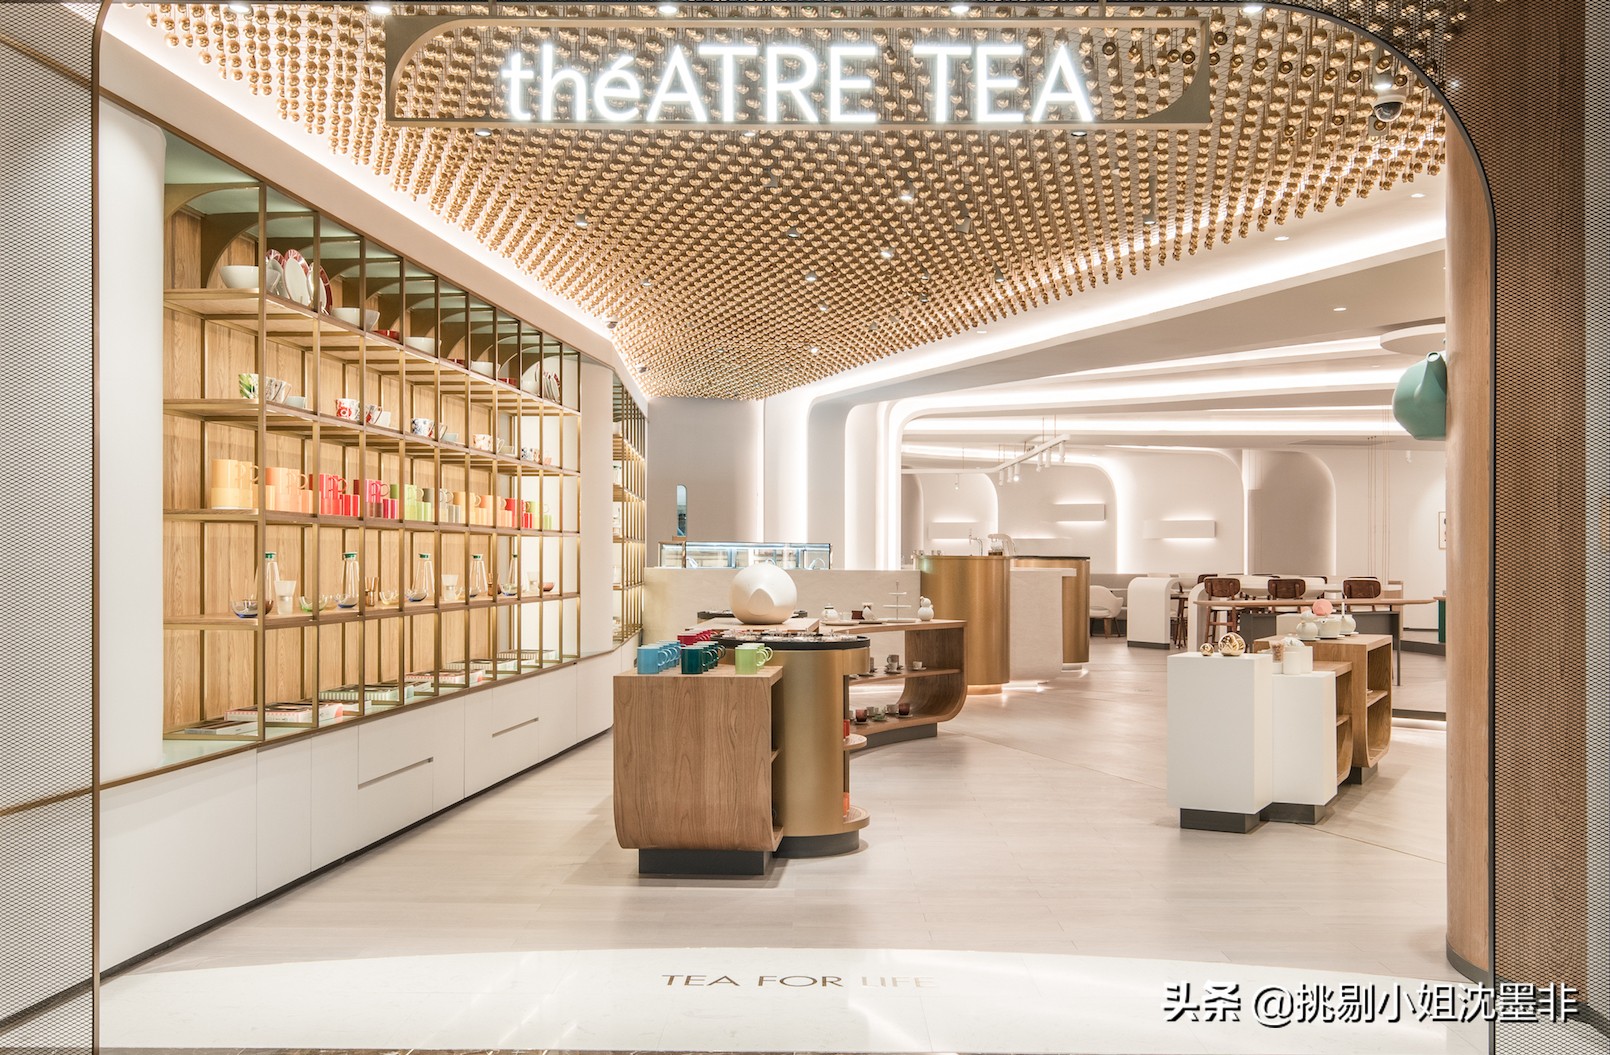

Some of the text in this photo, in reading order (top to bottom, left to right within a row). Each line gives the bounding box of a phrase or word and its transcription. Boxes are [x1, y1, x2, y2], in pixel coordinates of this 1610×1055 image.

[502, 44, 1094, 122] théATRE TEA
[662, 974, 937, 988] TEA FOR LIFE
